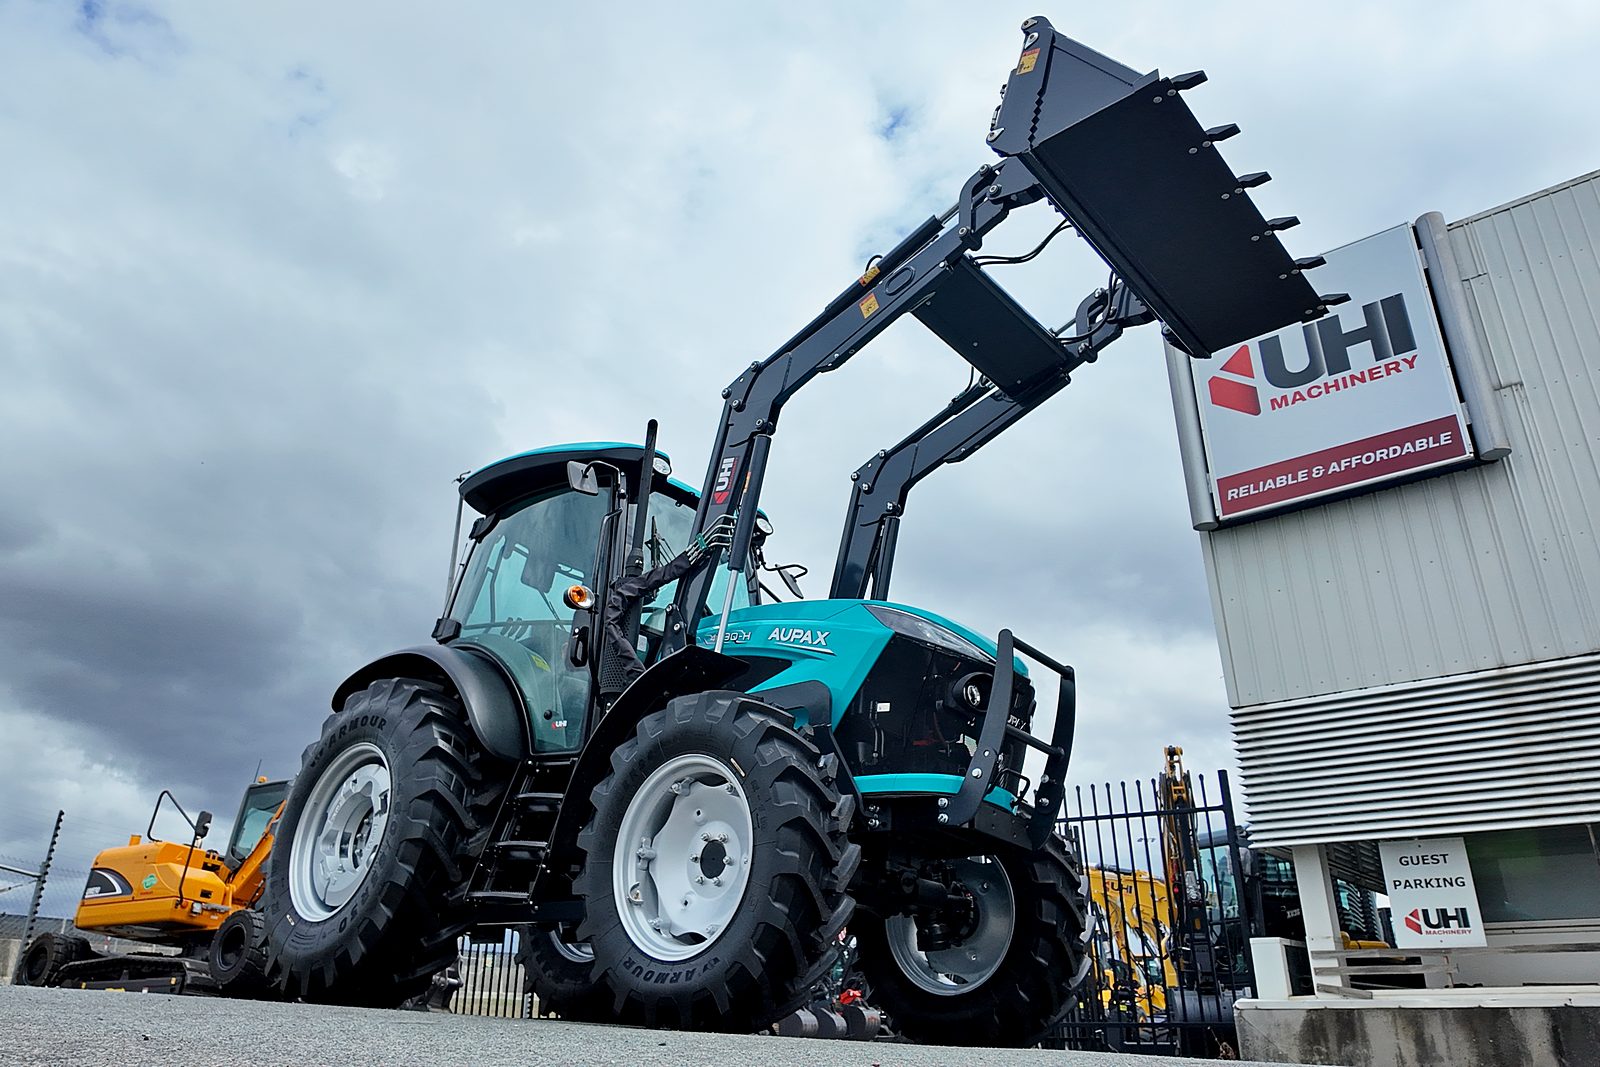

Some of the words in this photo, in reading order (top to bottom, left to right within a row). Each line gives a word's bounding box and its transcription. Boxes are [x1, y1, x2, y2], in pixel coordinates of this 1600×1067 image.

[1258, 293, 1417, 389] UHI
[1269, 354, 1418, 411] MACHINERY
[716, 457, 735, 491] UHI
[1227, 469, 1308, 501] RELIABLE
[1312, 466, 1325, 479] &
[1327, 431, 1452, 475] AFFORDABLE
[768, 627, 830, 646] AUPAX
[328, 715, 387, 748] ARMOUR
[1398, 853, 1449, 866] GUEST
[1392, 876, 1466, 890] PARKING
[1421, 907, 1471, 929] UHI
[622, 957, 697, 984] ARMOUR
